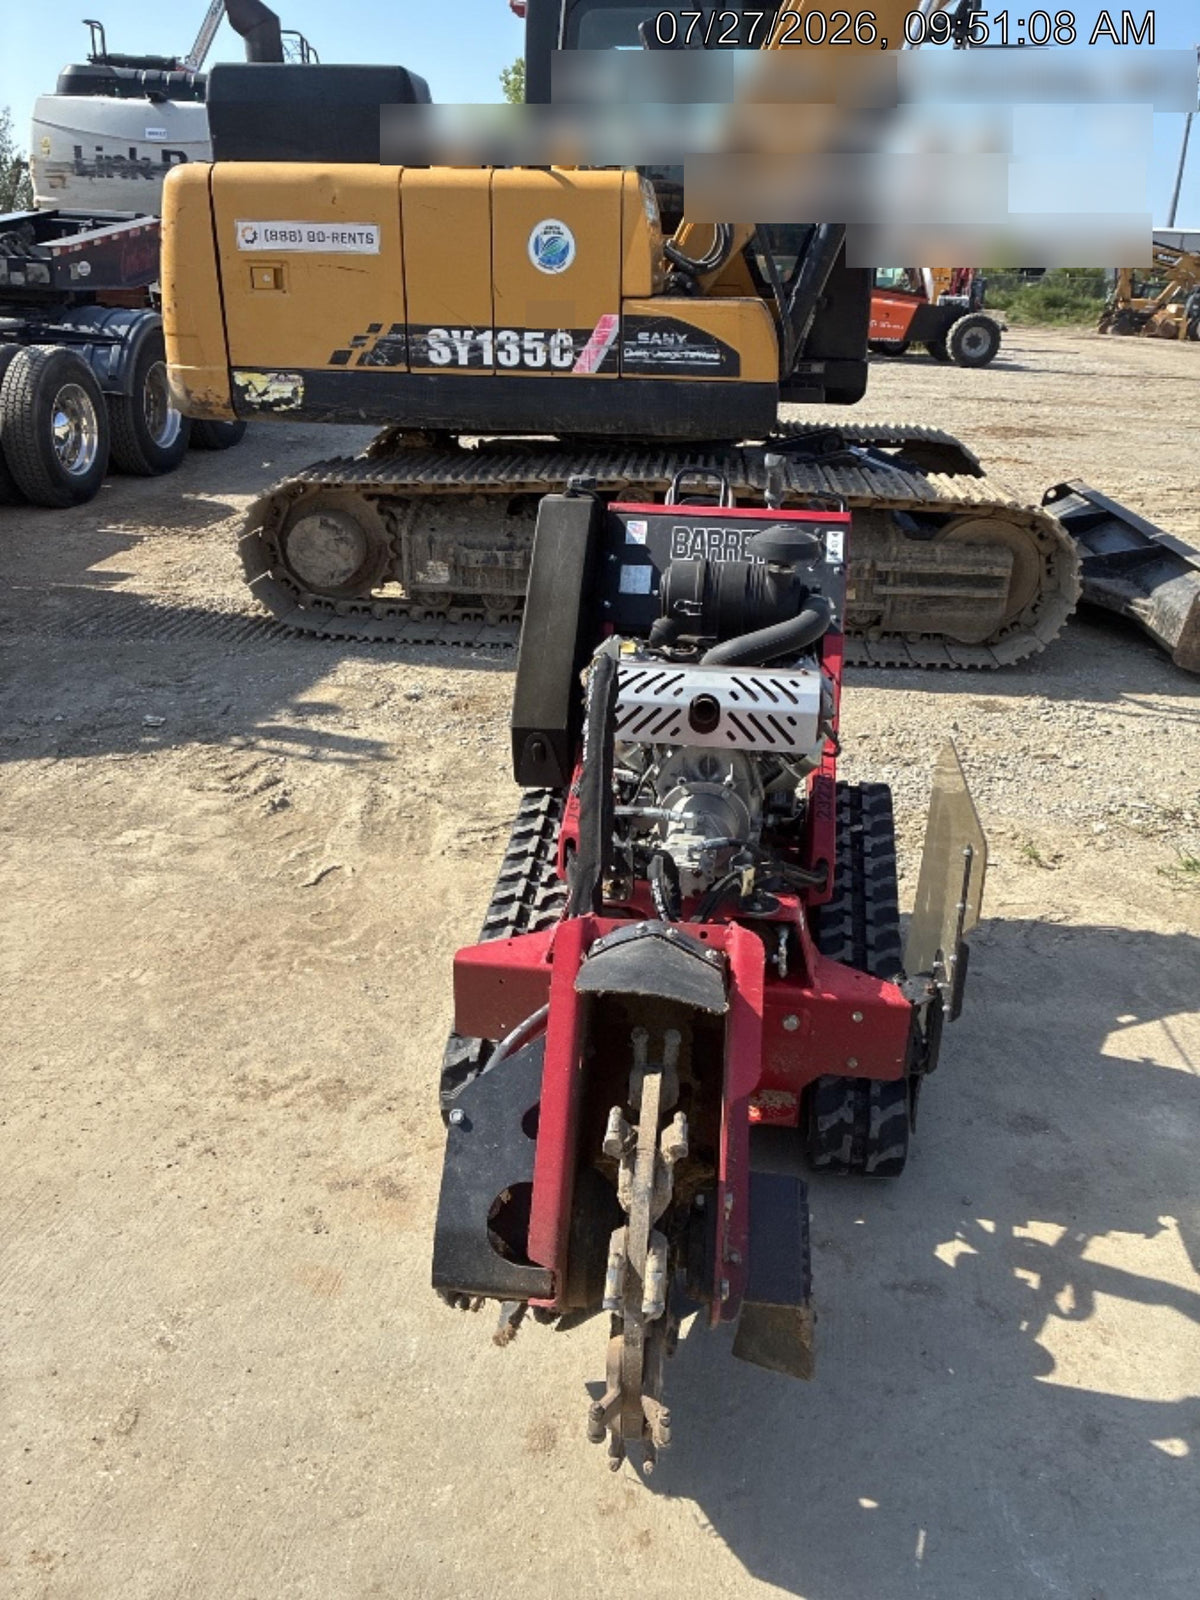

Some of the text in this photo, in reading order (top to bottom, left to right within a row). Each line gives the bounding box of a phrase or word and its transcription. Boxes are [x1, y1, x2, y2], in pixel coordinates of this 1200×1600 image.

[264, 229, 302, 243] (888)
[637, 332, 688, 345] SANY
[428, 328, 574, 367] SY135C
